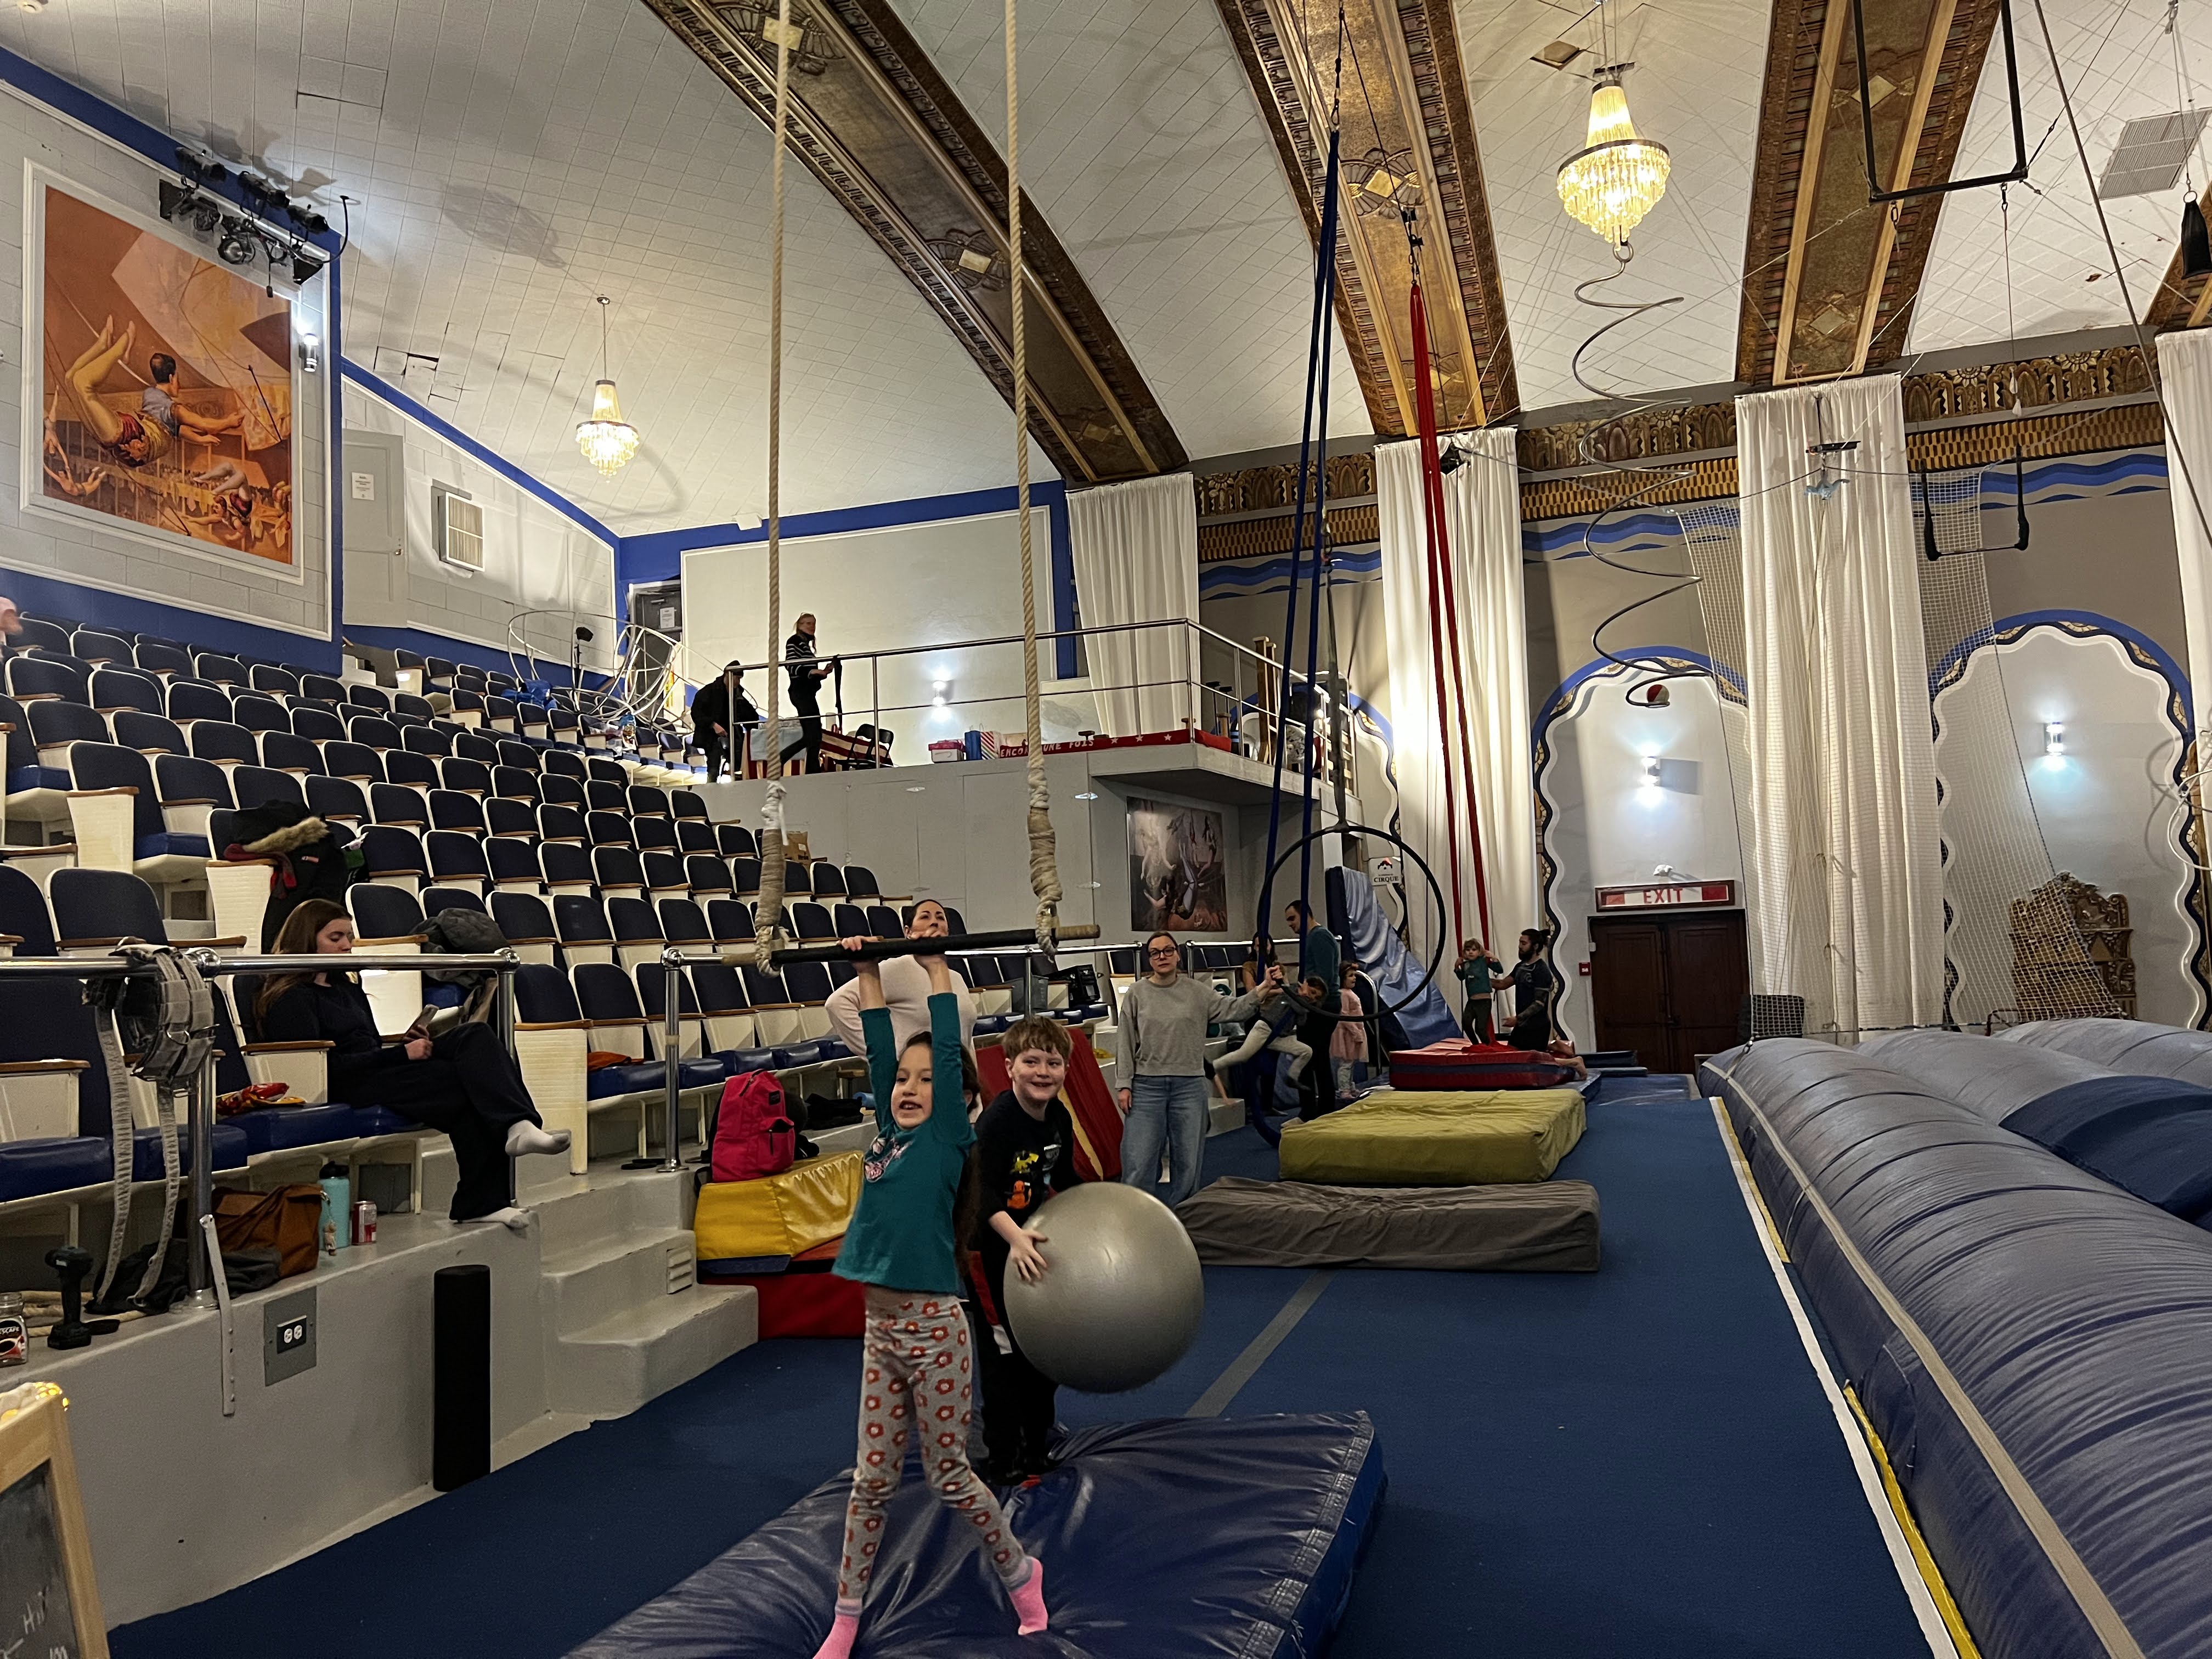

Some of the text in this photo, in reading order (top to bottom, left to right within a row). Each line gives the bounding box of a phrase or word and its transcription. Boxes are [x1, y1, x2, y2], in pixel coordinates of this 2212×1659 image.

[1000, 740, 1094, 757] ENCOR UNE FOIS
[1643, 887, 1683, 904] EXIT
